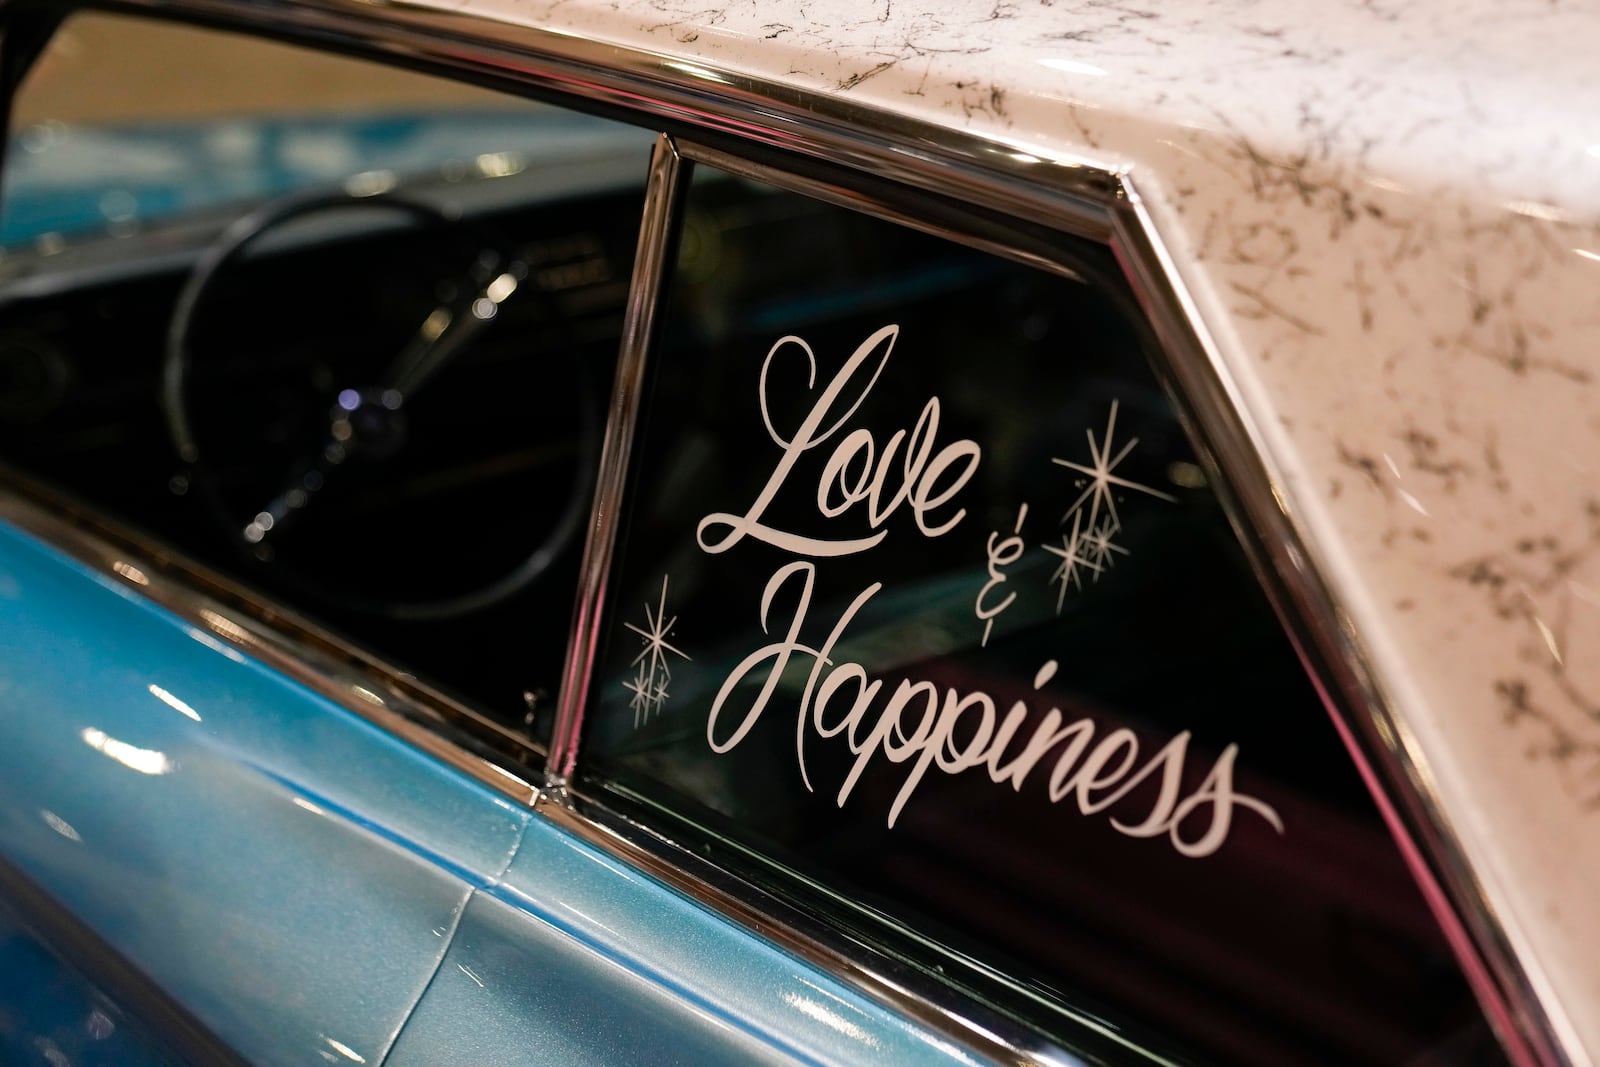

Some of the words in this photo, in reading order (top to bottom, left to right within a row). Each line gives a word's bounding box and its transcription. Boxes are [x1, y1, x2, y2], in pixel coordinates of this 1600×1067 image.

[696, 323, 981, 557] Love
[975, 502, 1029, 648] &
[706, 560, 1284, 858] Happiness
